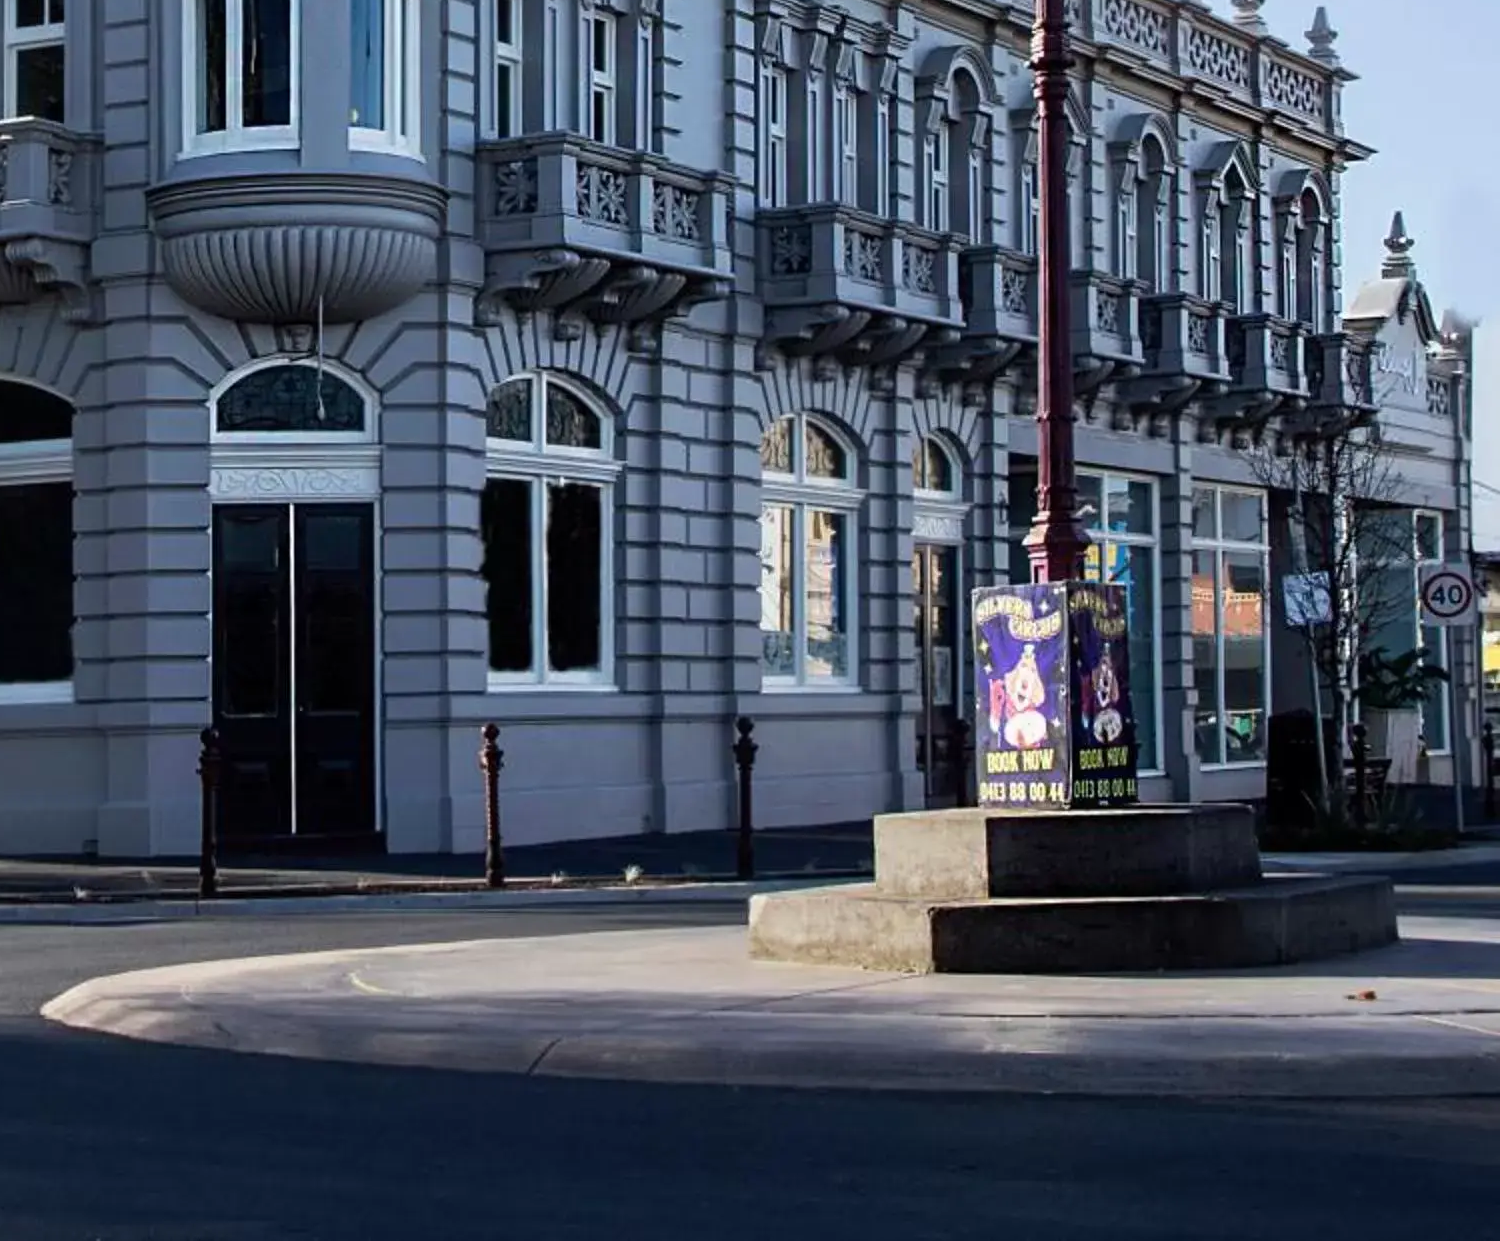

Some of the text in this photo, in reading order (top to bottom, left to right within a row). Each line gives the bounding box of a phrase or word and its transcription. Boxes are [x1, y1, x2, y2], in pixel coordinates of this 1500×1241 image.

[1431, 584, 1463, 605] 40
[987, 748, 1055, 773] BOOK NOW
[1079, 746, 1129, 770] BOOK NOW
[1073, 780, 1095, 799] 0413
